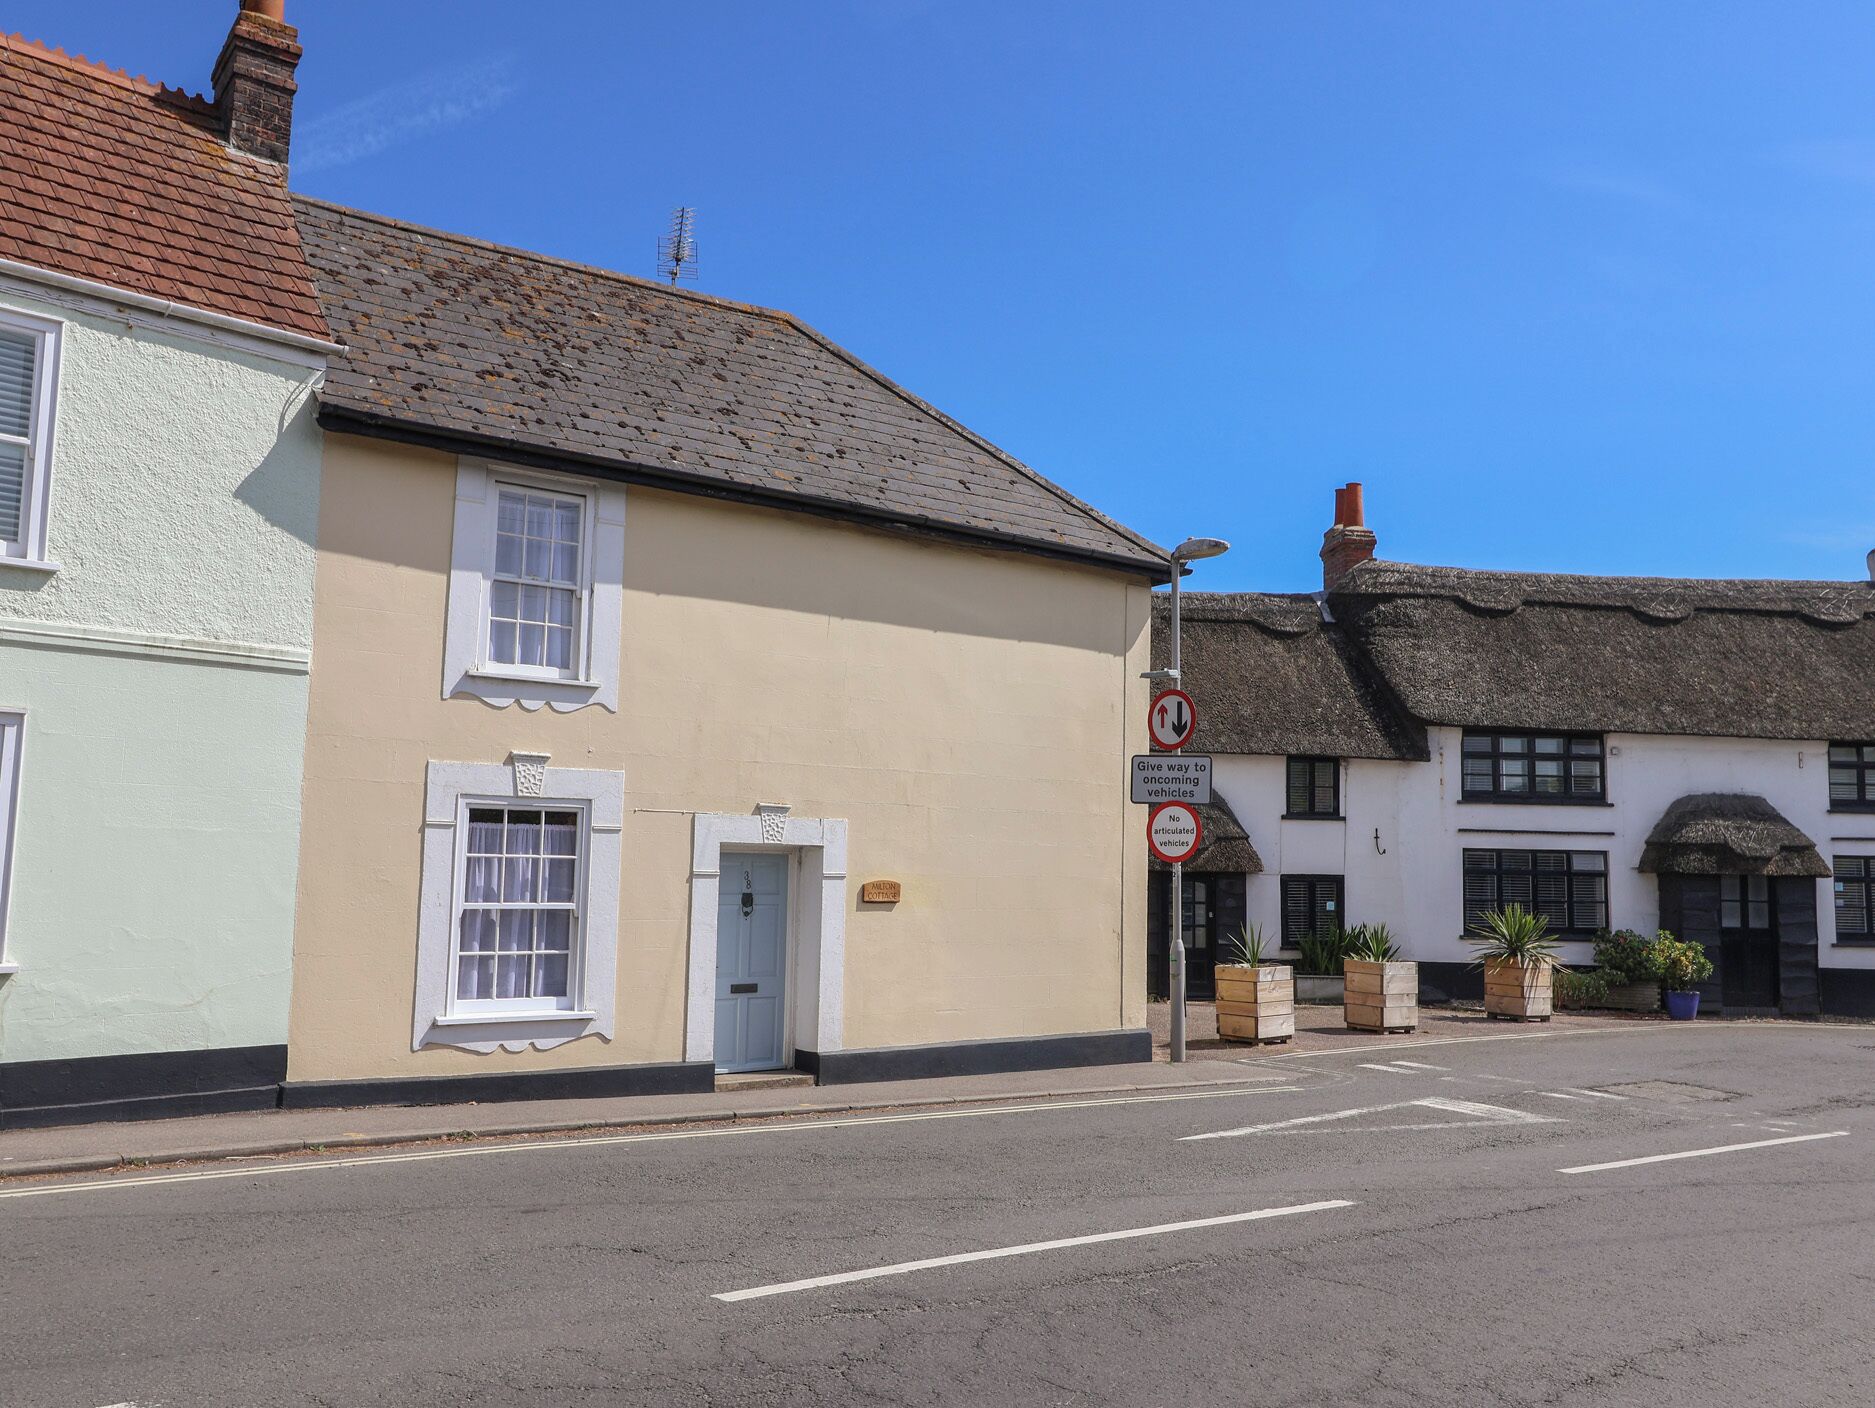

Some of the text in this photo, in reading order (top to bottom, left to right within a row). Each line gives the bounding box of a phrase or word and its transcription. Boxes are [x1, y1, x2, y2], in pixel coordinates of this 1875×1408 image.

[1137, 761, 1207, 774] Give way to
[1143, 775, 1200, 787] oncoming
[1147, 787, 1195, 798] vehicles
[1169, 815, 1181, 823] No
[1154, 827, 1195, 835] articulated
[871, 882, 896, 890] MILTON
[867, 891, 897, 900] COTTAGE
